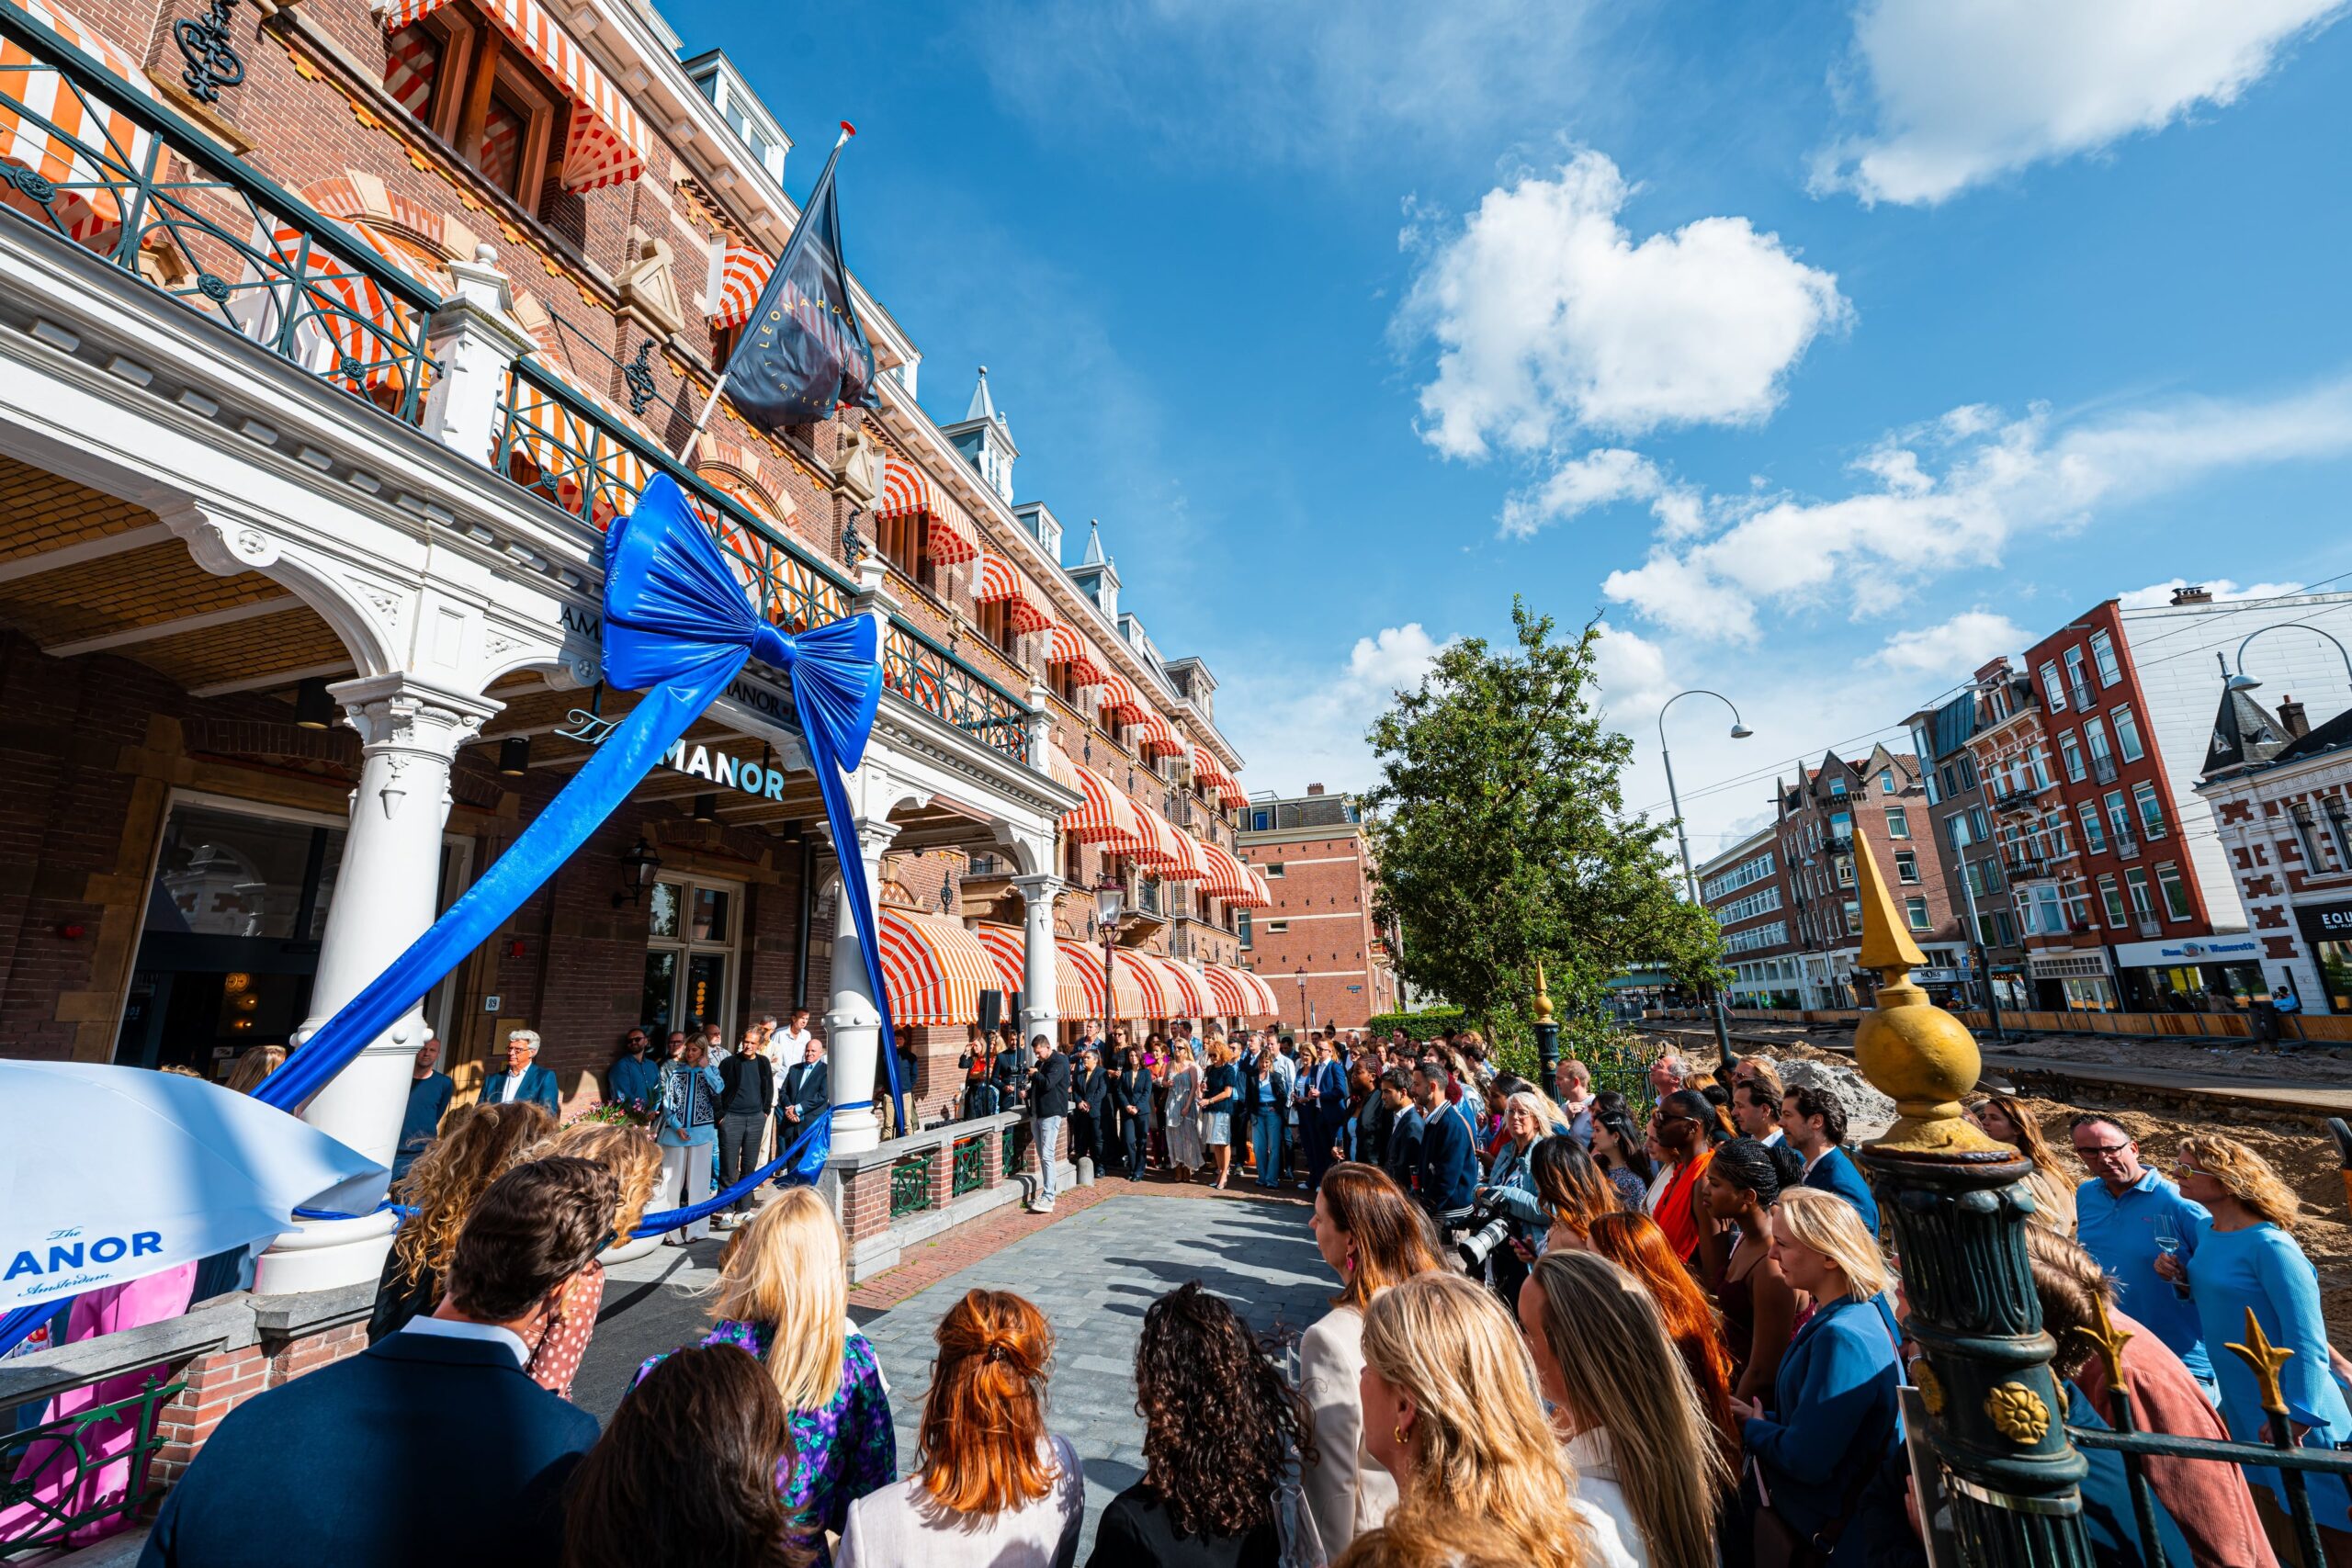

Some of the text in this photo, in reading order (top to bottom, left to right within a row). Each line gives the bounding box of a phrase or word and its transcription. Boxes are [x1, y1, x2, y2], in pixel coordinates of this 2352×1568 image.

[759, 299, 853, 349] LEONARDO
[656, 738, 784, 801] MANOR
[1921, 970, 1941, 978] MOSS
[488, 998, 497, 1009] 89
[46, 1225, 84, 1240] The
[17, 1273, 114, 1297] Amsterdam
